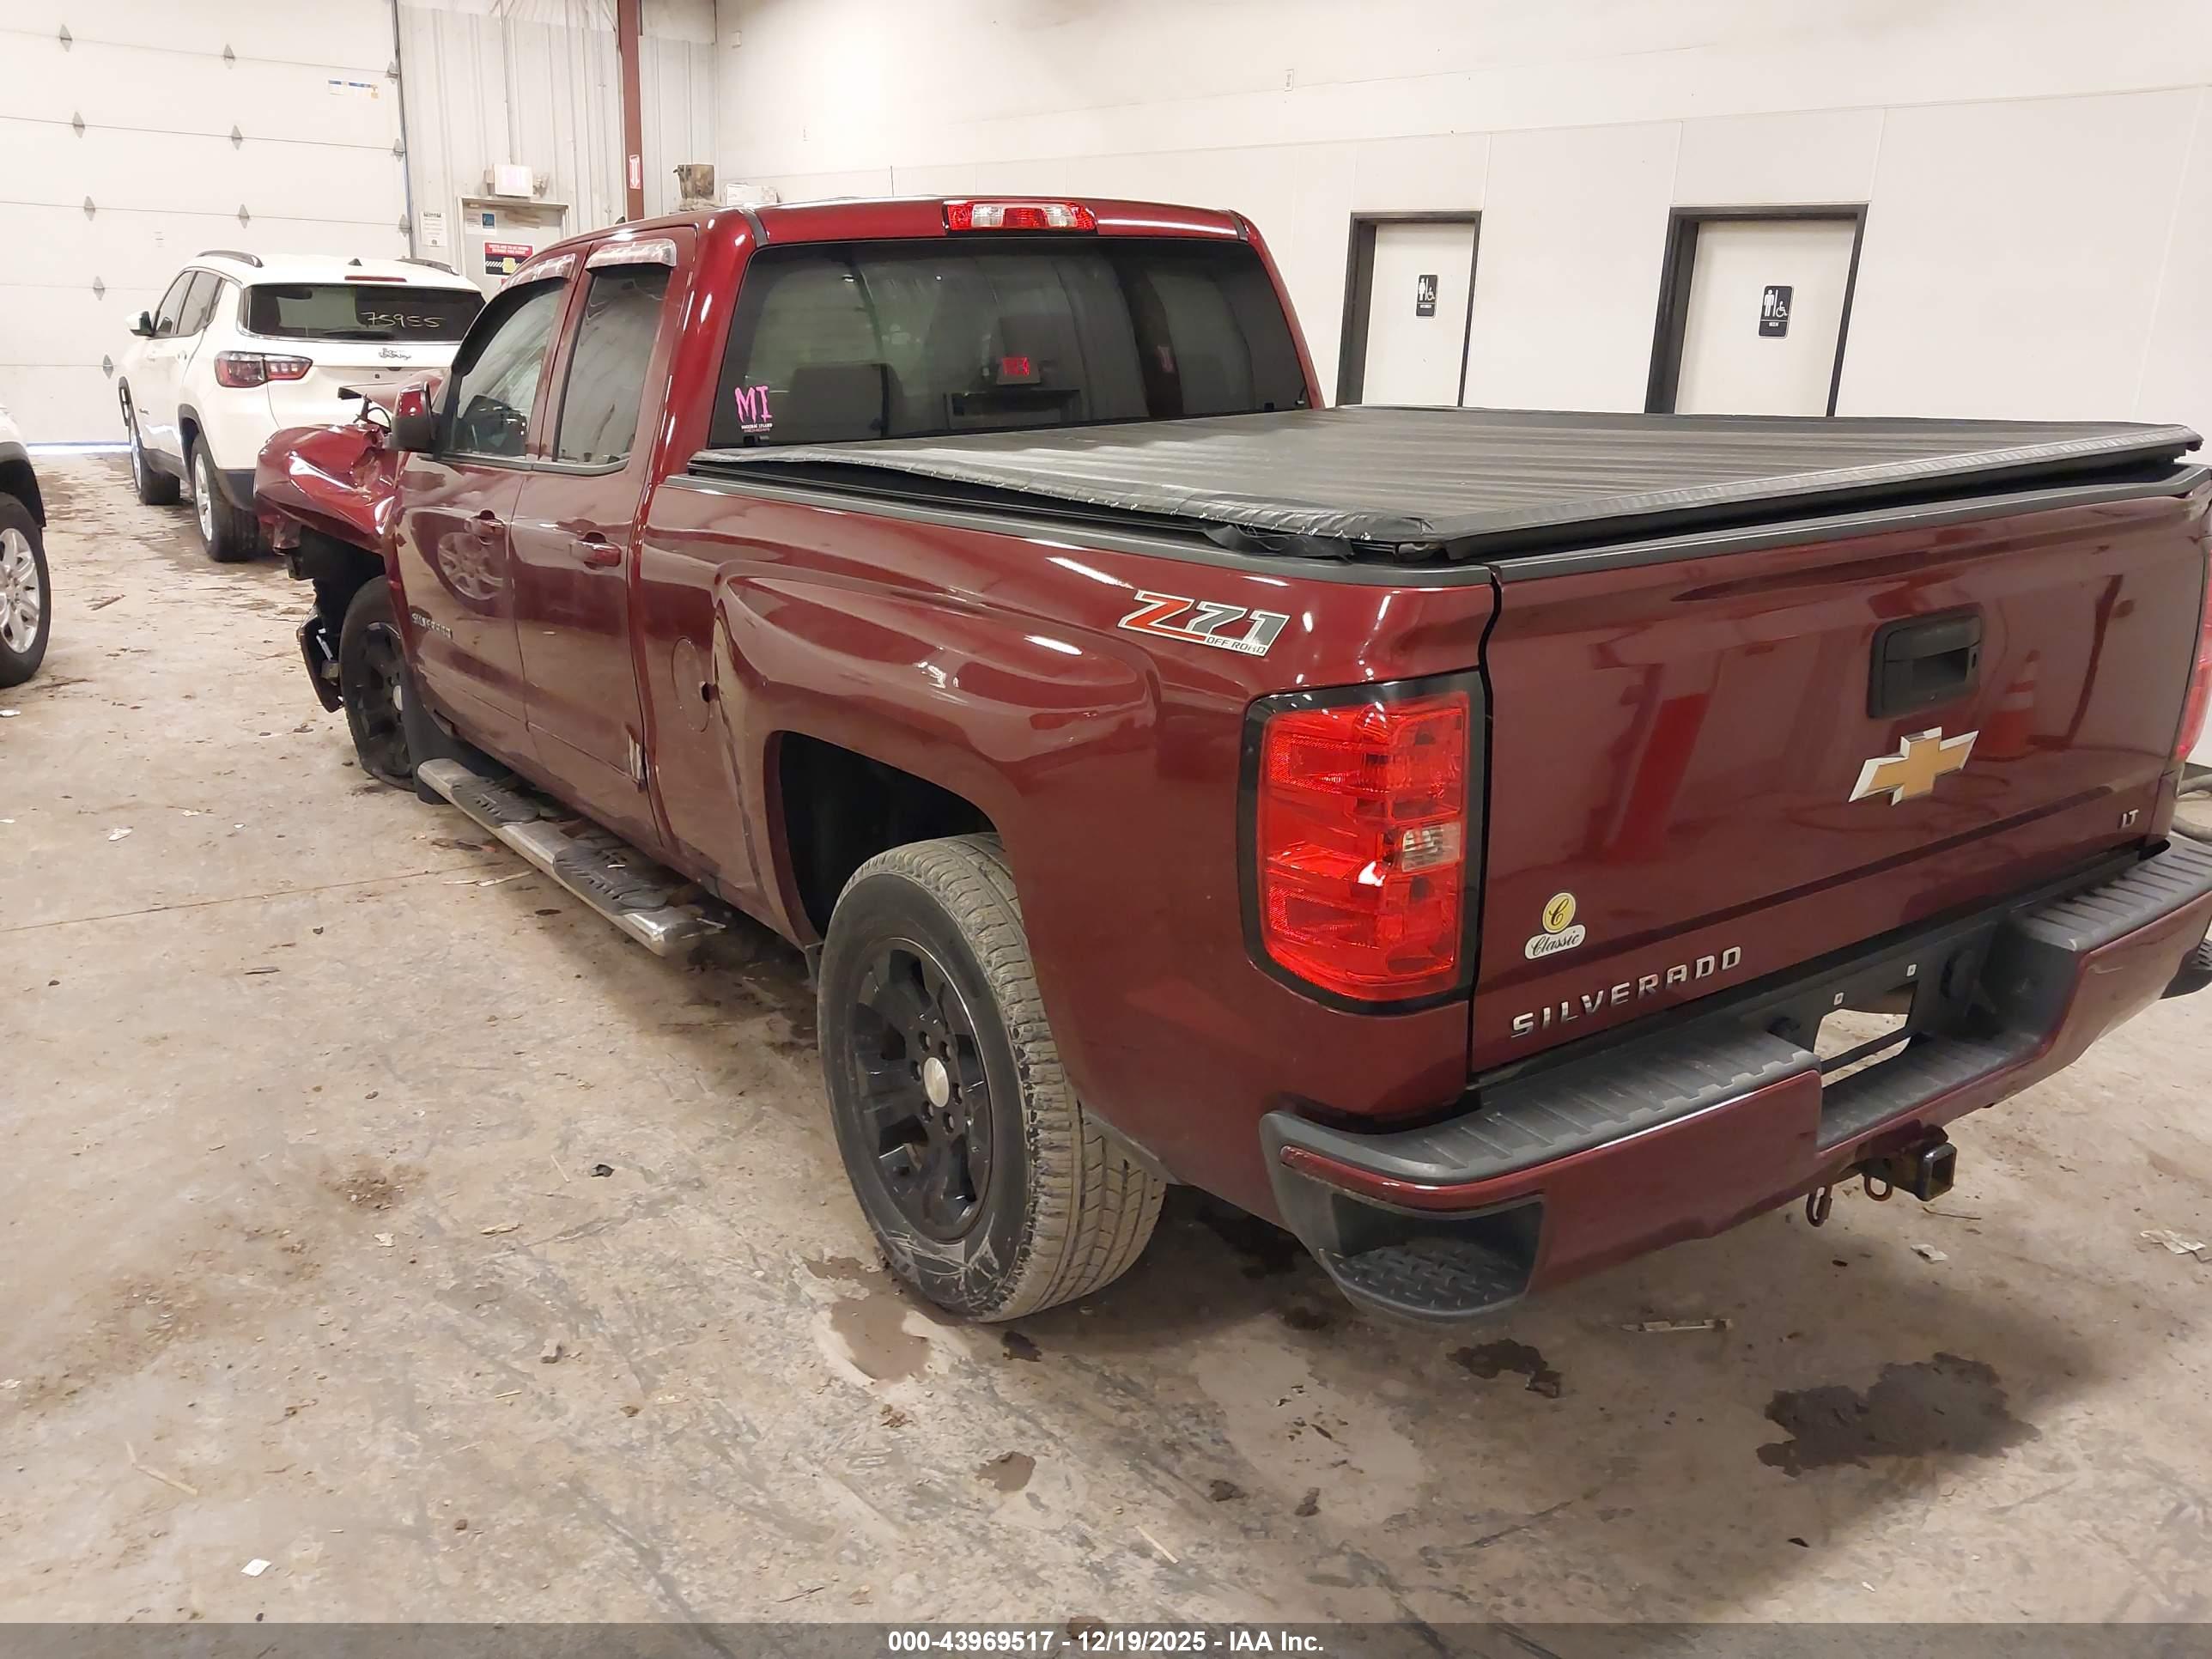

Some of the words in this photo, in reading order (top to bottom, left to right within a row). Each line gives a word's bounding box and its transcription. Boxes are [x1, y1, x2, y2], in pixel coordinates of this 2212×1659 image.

[735, 385, 772, 423] MI
[1117, 589, 1291, 649] Z71
[1206, 635, 1231, 647] OFF
[1231, 640, 1267, 654] ROAD
[1530, 930, 1580, 957] Classic
[1510, 946, 1741, 1038] SILVERADO
